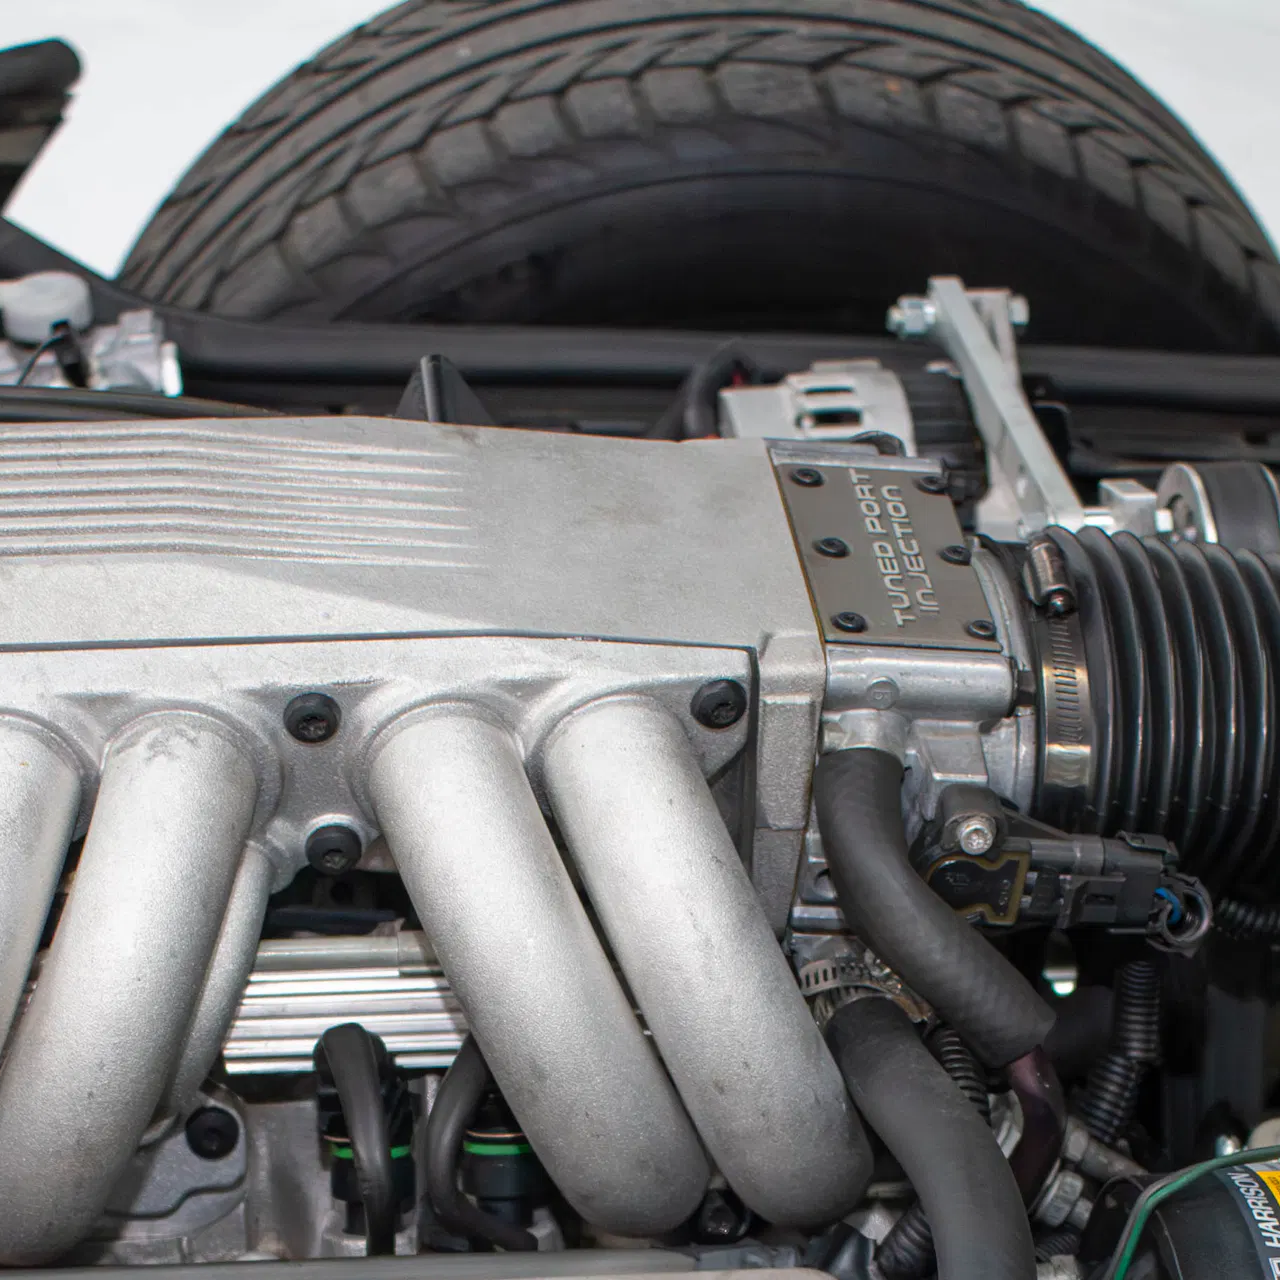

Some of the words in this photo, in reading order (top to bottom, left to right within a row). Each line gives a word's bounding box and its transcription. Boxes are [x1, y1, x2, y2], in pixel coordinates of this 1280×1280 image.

[848, 468, 888, 535] PORT
[872, 539, 917, 627] TUNED
[881, 484, 940, 612] INJECTION
